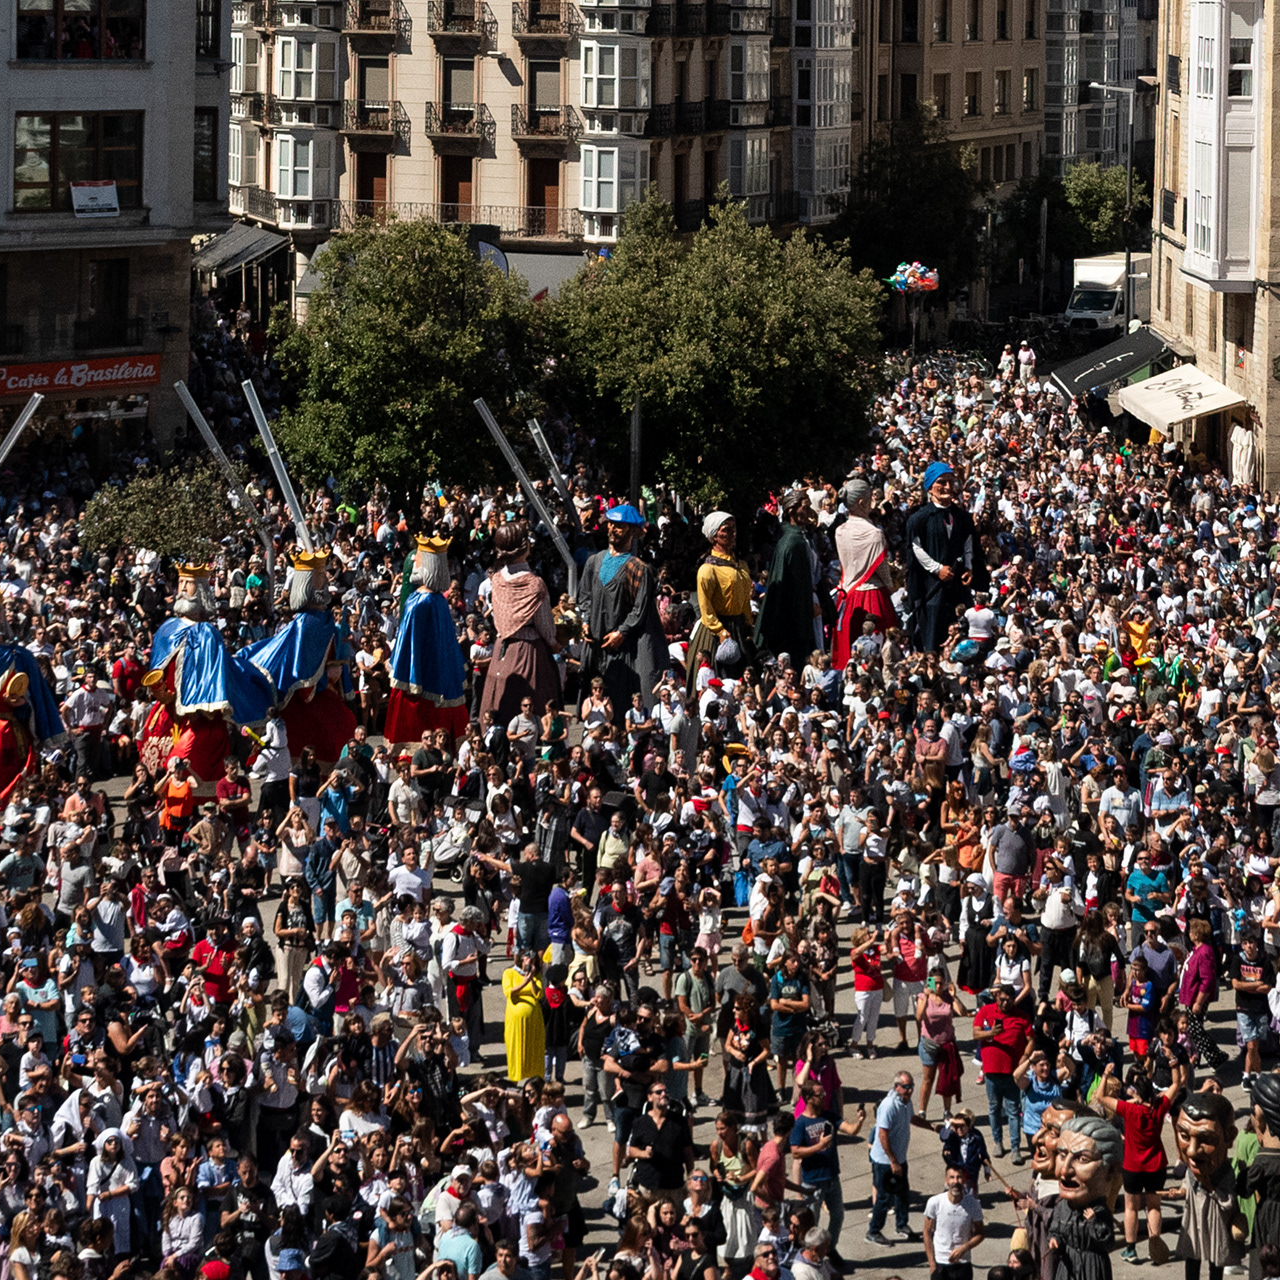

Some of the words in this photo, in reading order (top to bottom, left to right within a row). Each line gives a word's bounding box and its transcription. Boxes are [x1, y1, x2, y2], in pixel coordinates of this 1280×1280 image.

[6, 375, 50, 390] Cafés
[54, 367, 69, 386] la
[69, 361, 156, 388] Brasileña
